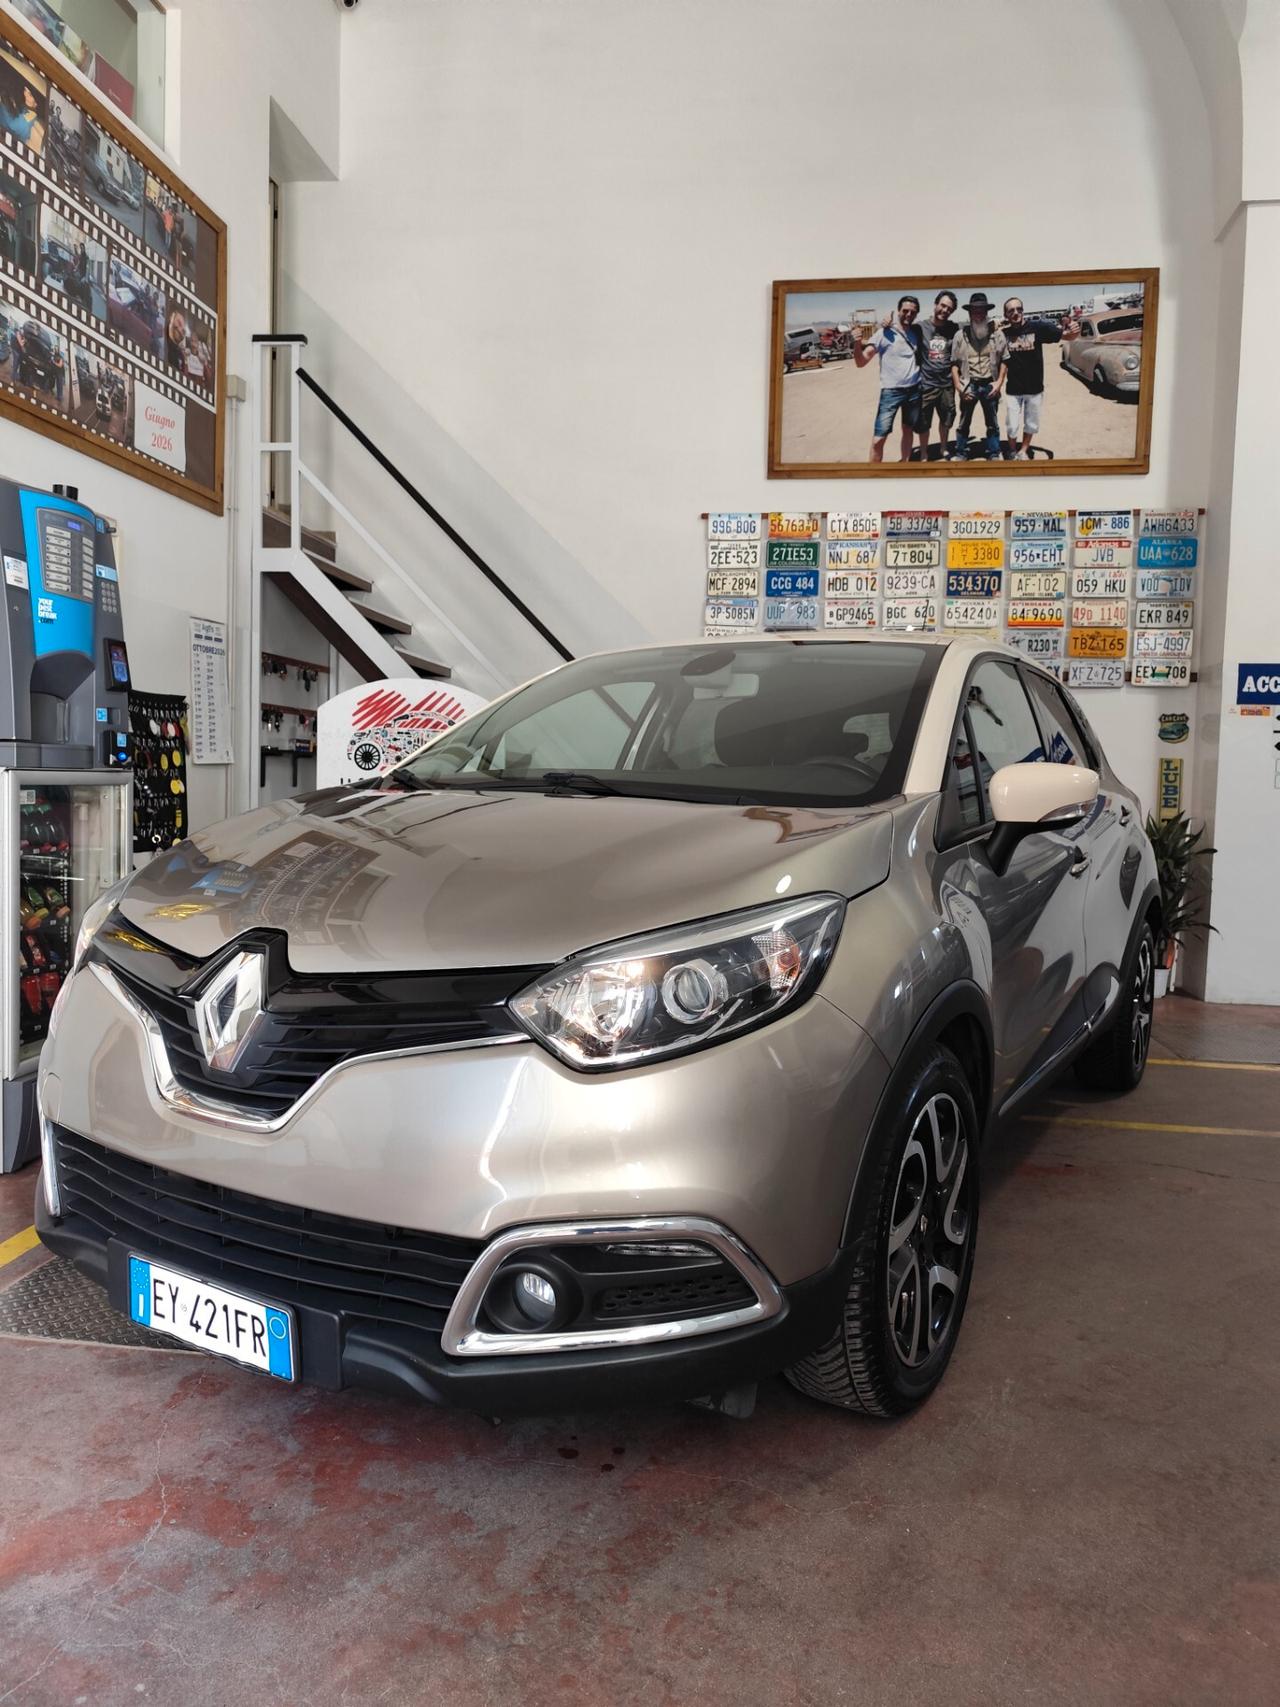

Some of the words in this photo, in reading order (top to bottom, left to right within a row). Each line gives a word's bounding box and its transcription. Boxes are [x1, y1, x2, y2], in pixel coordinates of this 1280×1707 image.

[144, 406, 176, 430] Giugno
[151, 432, 173, 452] 2026
[712, 520, 731, 534] 996
[831, 520, 848, 533] CTX
[852, 519, 877, 532] 8505
[907, 516, 939, 531] 33794
[1143, 518, 1195, 532] AWH6433
[828, 550, 849, 564] NNJ
[856, 550, 877, 564] 687
[973, 547, 1000, 561] 3380
[1014, 549, 1035, 563] 956
[1041, 548, 1063, 563] EHT
[1092, 548, 1114, 562] JVB
[1140, 546, 1162, 561] UAA
[1171, 546, 1193, 561] 628
[771, 577, 792, 590] CCG
[796, 577, 814, 590] 484
[856, 576, 877, 592] 012
[948, 575, 999, 591] 534370
[1017, 577, 1059, 592] AF-102
[1076, 579, 1098, 593] 059
[1104, 579, 1126, 593] HKU
[797, 605, 816, 619] 983
[886, 606, 907, 619] BGC
[1100, 607, 1126, 621] 1140
[1139, 609, 1162, 623] EKR
[1166, 609, 1189, 623] 849
[1027, 639, 1050, 652] R230
[1136, 636, 1191, 651] ESJ-4997
[1070, 666, 1093, 681] XFZ
[1101, 666, 1122, 681] 725
[1166, 665, 1187, 679] 708
[153, 1278, 180, 1324] EY
[189, 1294, 267, 1358] 421FR
